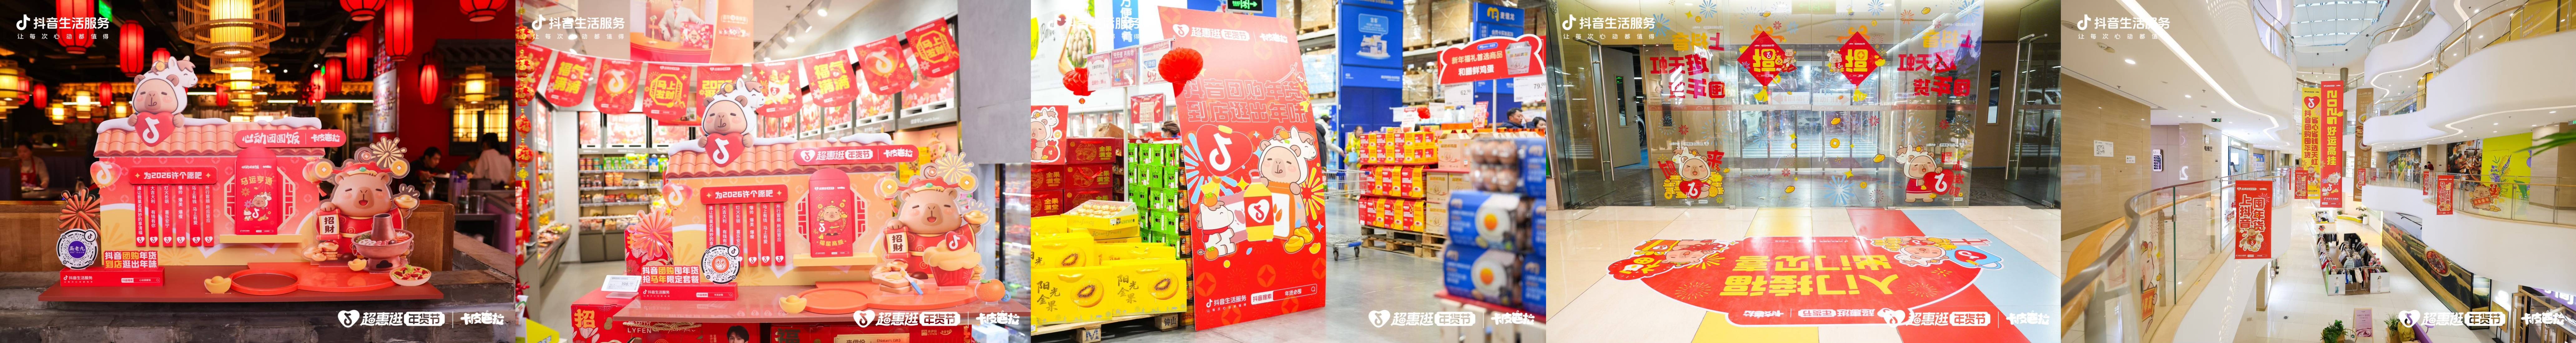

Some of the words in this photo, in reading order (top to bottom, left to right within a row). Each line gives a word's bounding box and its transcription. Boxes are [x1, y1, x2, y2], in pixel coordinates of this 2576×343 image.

[1191, 27, 1221, 39] 超惠逛
[1224, 30, 1248, 40] 年货节
[922, 36, 941, 49] 马上
[926, 46, 945, 58] 发财
[1452, 51, 1503, 64] 新年福礼首选商品
[558, 62, 586, 79] 福气
[814, 60, 846, 80] 福气
[553, 76, 582, 94] 满满
[657, 80, 676, 89] 马上
[818, 75, 850, 94] 满满
[1184, 78, 1304, 101] 抖音团购年货
[656, 90, 675, 99] 发财
[1186, 101, 1307, 123] 到店逛出年味
[2327, 90, 2337, 165] 2026好运高挂
[242, 132, 300, 144] 心动团圆饭
[816, 150, 845, 160] 超惠逛
[848, 150, 870, 159] 年货节
[240, 176, 272, 186] 马运亨通
[715, 190, 773, 199] 为2026许个愿吧
[2239, 194, 2252, 229] 上抖音
[2253, 197, 2266, 232] 囤年货
[324, 217, 334, 233] 招財
[892, 235, 903, 252] 招財
[105, 252, 156, 260] 抖音团购年货
[105, 260, 157, 268] 到店逛出年味
[1732, 255, 1892, 271] 出门见喜
[642, 267, 699, 275] 抖音团购囤年货
[643, 275, 699, 283] 抢马年限定套餐
[1719, 274, 1899, 296] 入门接福
[1214, 295, 1246, 306] 抖音生活服务
[1253, 294, 1272, 302] 抖音搜索
[574, 309, 596, 328] 招
[1837, 308, 1875, 316] 超惠逛
[1164, 317, 1176, 326] 钟山
[1085, 330, 1099, 341] M
